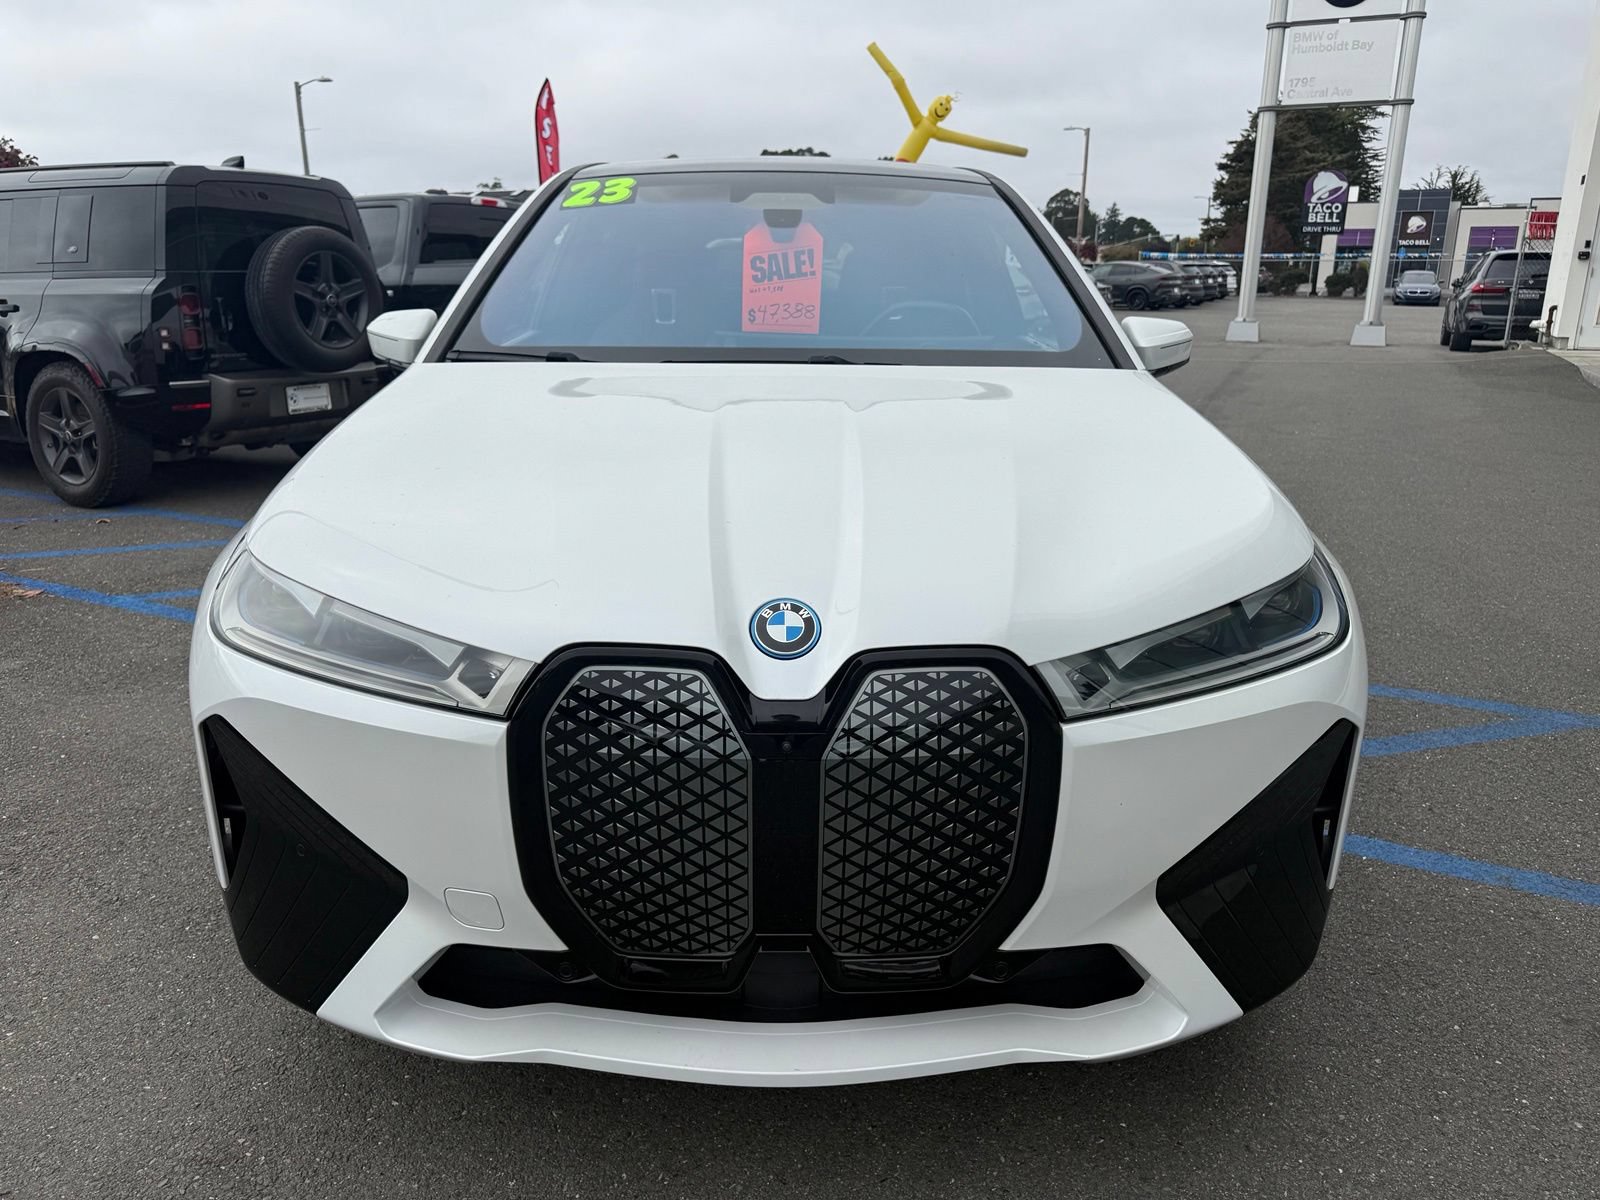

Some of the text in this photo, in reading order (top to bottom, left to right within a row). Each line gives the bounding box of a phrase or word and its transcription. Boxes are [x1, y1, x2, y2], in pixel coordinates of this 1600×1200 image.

[1293, 30, 1339, 43] BMW of
[1291, 40, 1375, 54] Humboldt Bay
[1287, 87, 1353, 99] Ctral Ave
[562, 177, 637, 208] 23
[1307, 203, 1342, 213] TACO
[1307, 213, 1340, 223] BELL
[1302, 225, 1322, 233] DRIVE
[750, 248, 816, 283] SALE!
[761, 603, 811, 619] BMW
